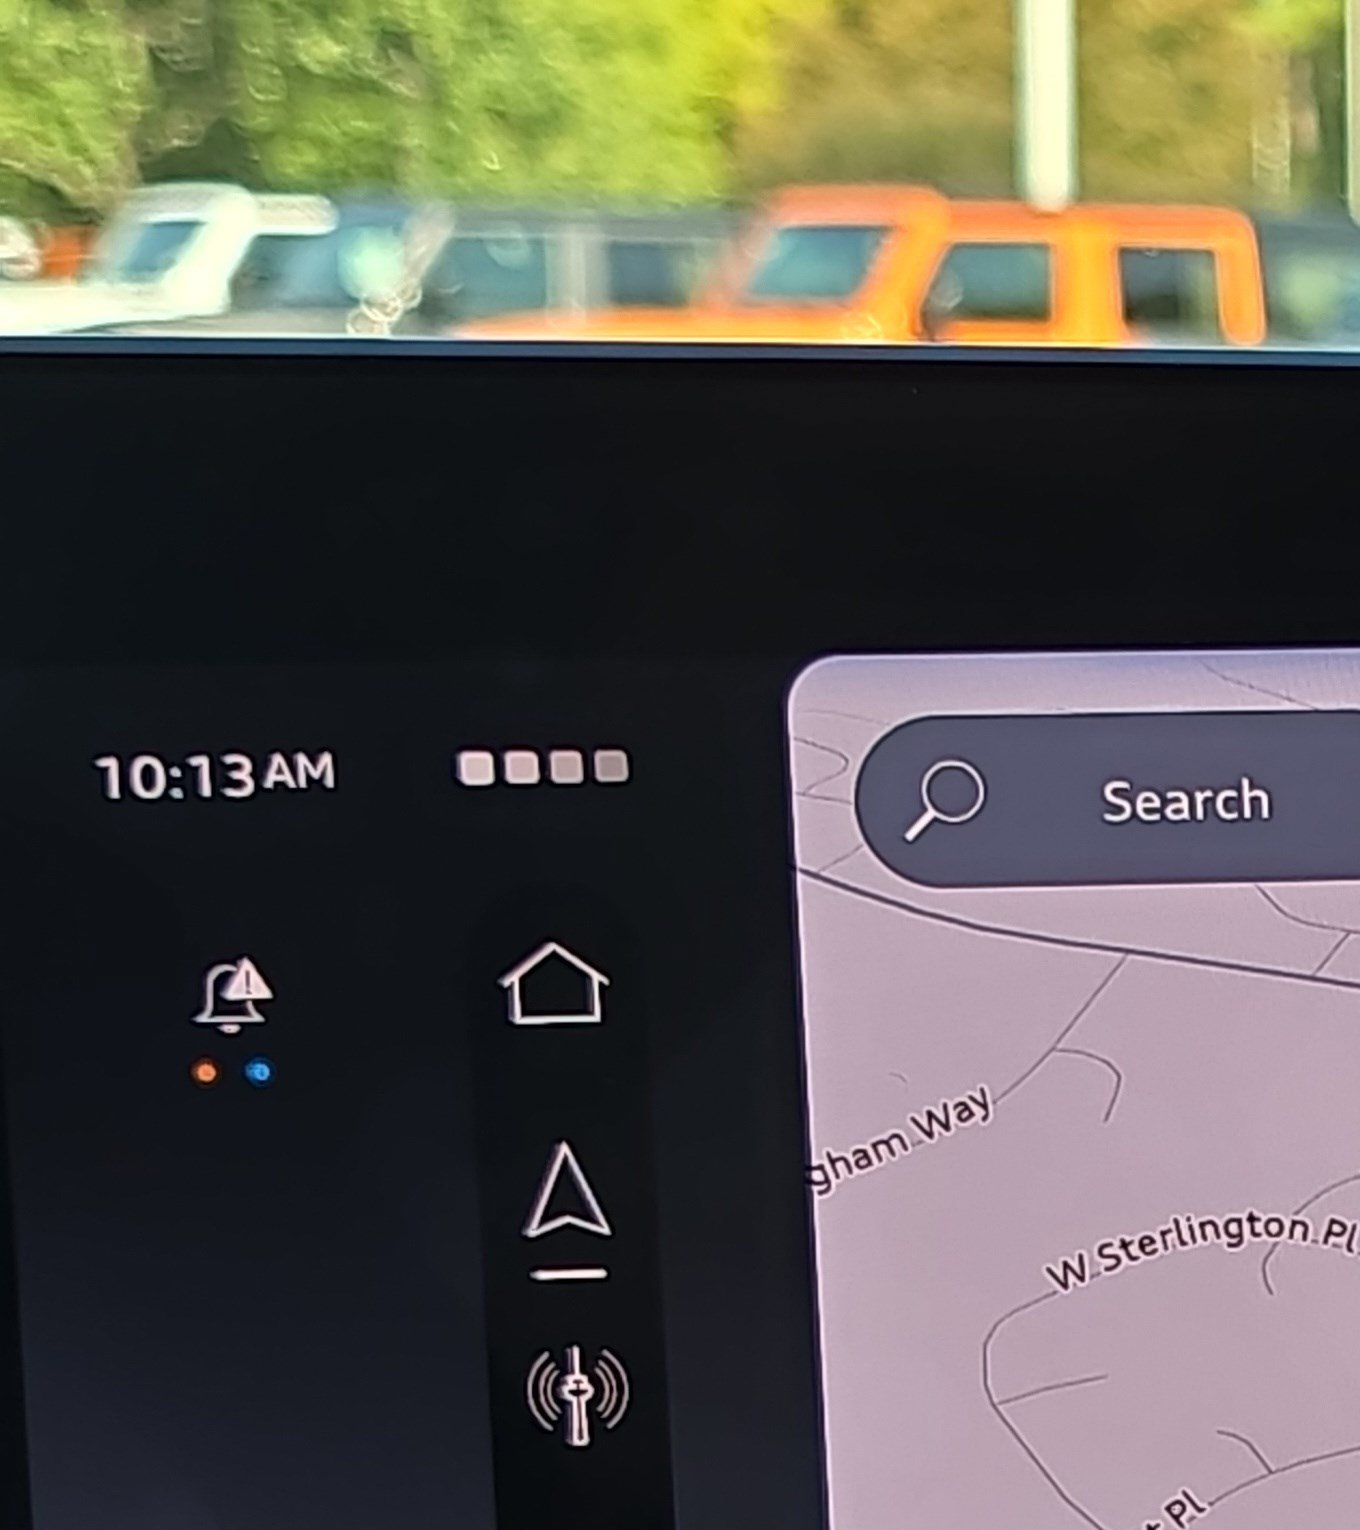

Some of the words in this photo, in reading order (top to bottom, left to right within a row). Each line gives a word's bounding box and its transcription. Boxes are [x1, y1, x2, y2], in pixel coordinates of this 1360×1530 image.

[1102, 777, 1271, 824] Search
[805, 1131, 909, 1196] gham
[910, 1086, 991, 1140] Way
[1045, 1253, 1090, 1292] W
[1098, 1211, 1309, 1273] Sterlington
[1322, 1218, 1358, 1254] Pl
[1164, 1489, 1207, 1530] Pl
